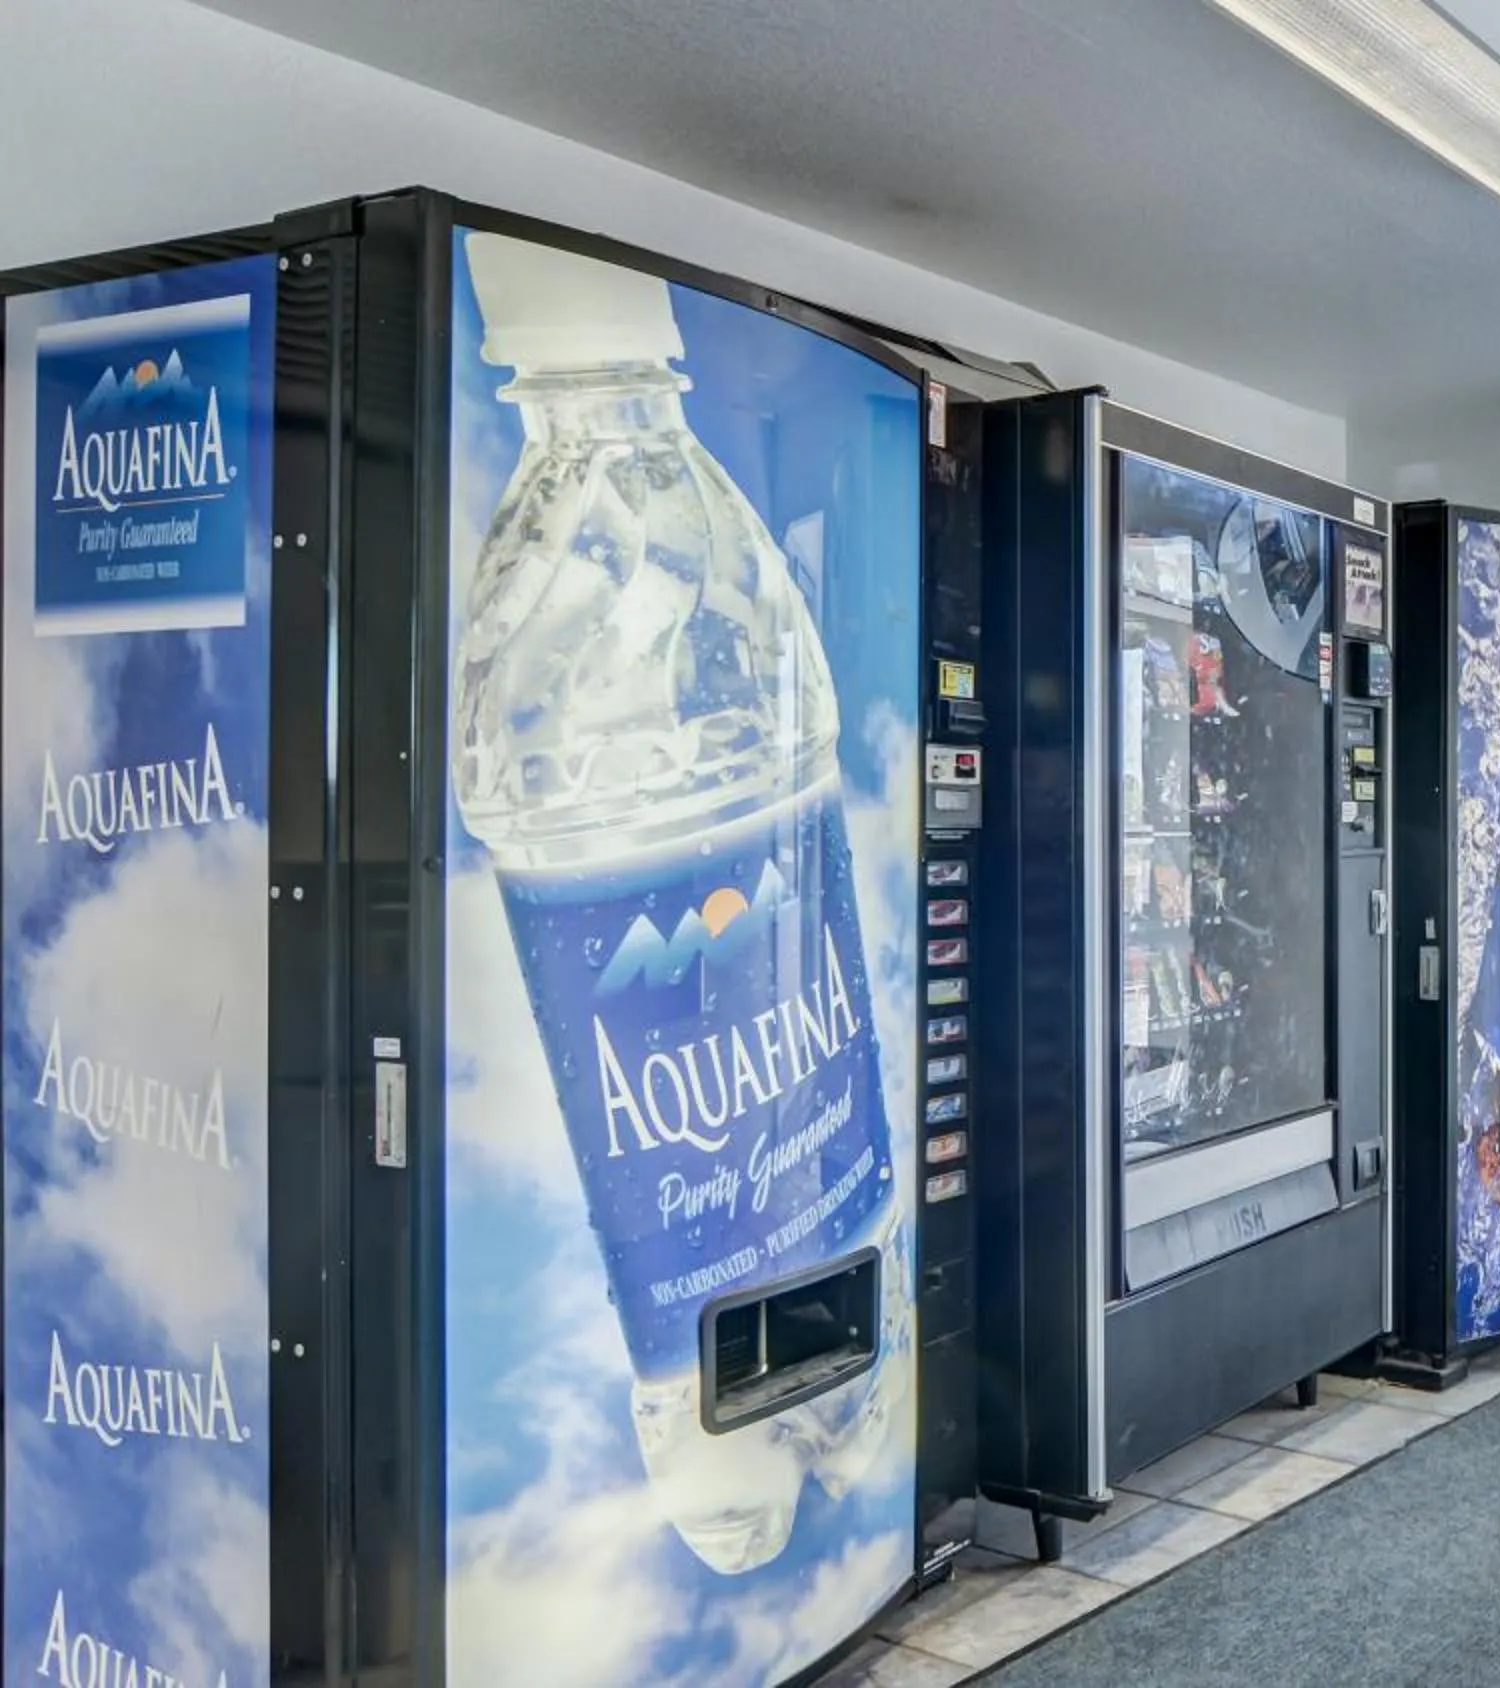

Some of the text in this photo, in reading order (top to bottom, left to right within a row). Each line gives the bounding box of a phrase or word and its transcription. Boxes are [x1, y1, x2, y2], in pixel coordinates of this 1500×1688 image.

[53, 385, 229, 511] AQUAFINA
[78, 509, 200, 560] Purity Guaranteed
[38, 722, 237, 852] AQUAFINA
[34, 1016, 232, 1170] AQUAFINA
[593, 922, 858, 1158] AQUAFINA
[658, 1075, 852, 1231] Purity Guaranteed
[650, 1245, 758, 1306] NON-CARBONATED
[766, 1205, 818, 1257] PURIFIED
[44, 1329, 243, 1446] AQUAFINA
